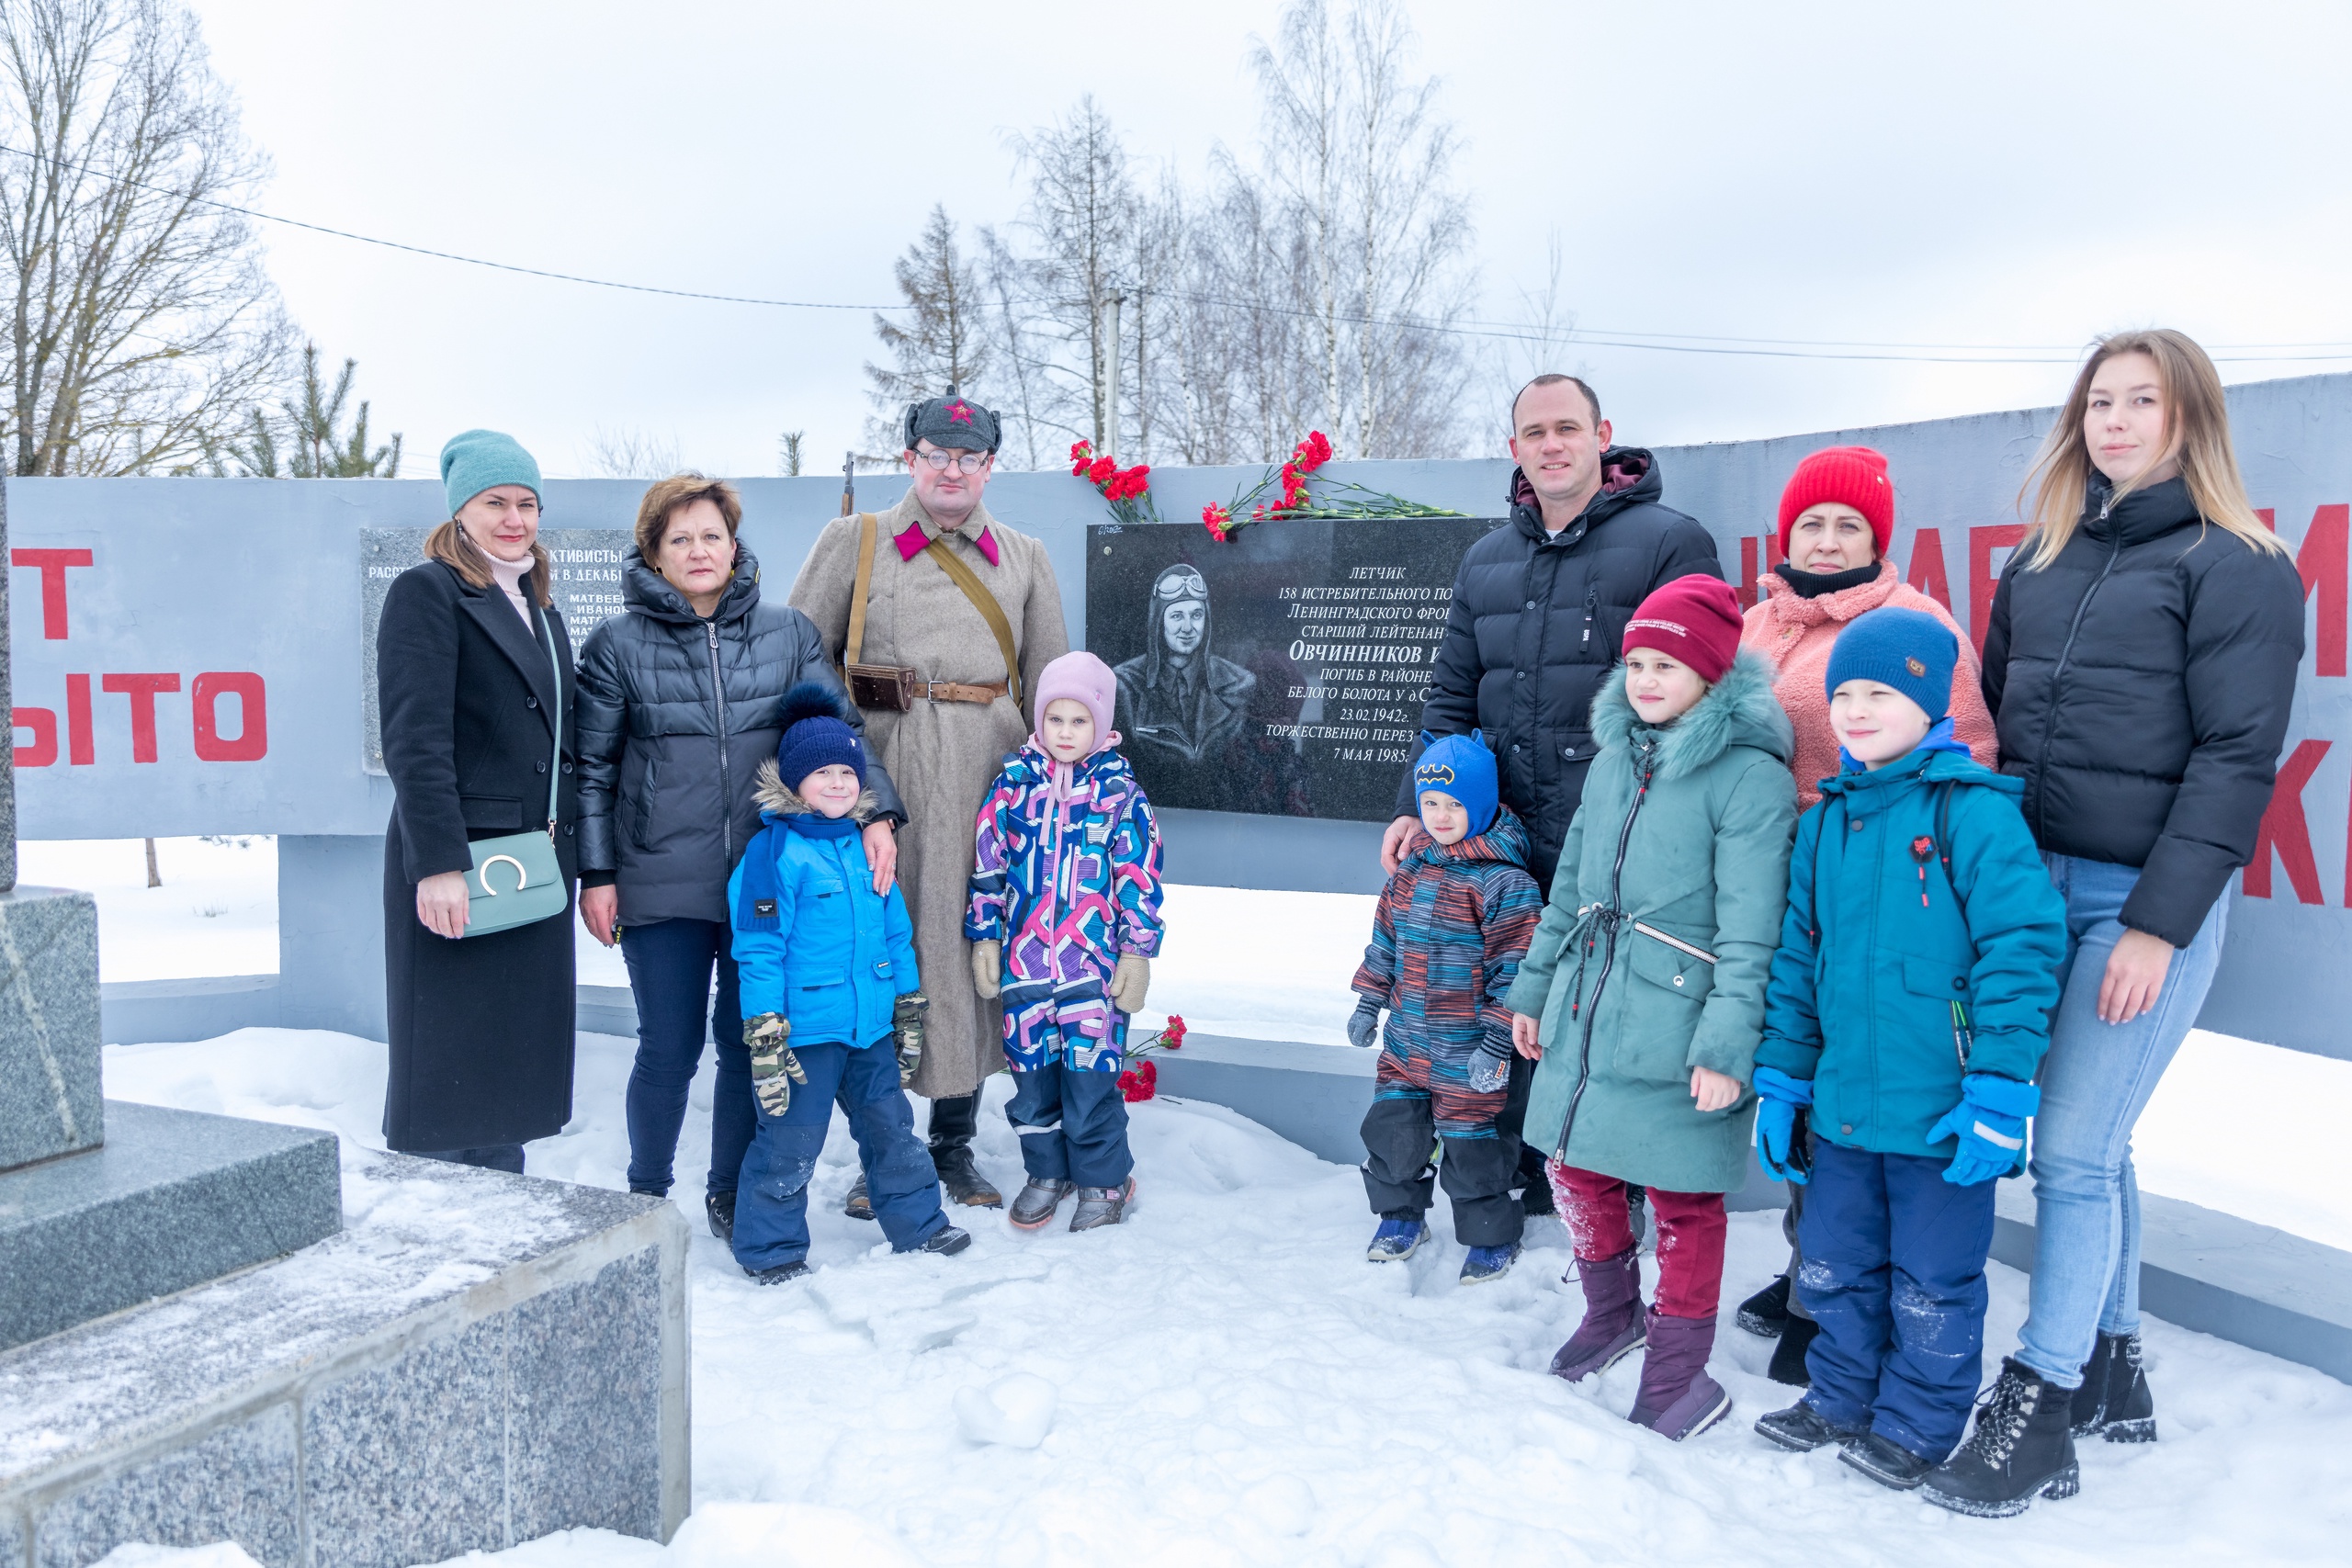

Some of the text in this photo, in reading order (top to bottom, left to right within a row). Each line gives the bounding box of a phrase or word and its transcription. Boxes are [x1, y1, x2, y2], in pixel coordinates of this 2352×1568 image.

[369, 567, 411, 579] РАССТ
[563, 570, 571, 581] В
[1349, 567, 1407, 580] ЛЕТЧИК
[1279, 587, 1297, 599] 158
[1301, 587, 1430, 601] ИСТРЕБИТЕЛЬНОГО
[570, 616, 603, 625] МАТ
[1301, 623, 1449, 639] СТАРШИЙ ЛЕЙТЕНАН
[1319, 667, 1433, 683] ПОГИБ В РАЙОНЕ
[1287, 686, 1338, 699] БЕЛОГО
[1341, 688, 1391, 701] БОЛОТА
[1396, 689, 1405, 702] У
[1266, 724, 1369, 740] ТОРЖЕСТВЕННО
[1333, 748, 1340, 760] 7
[1342, 749, 1374, 761] МАЯ
